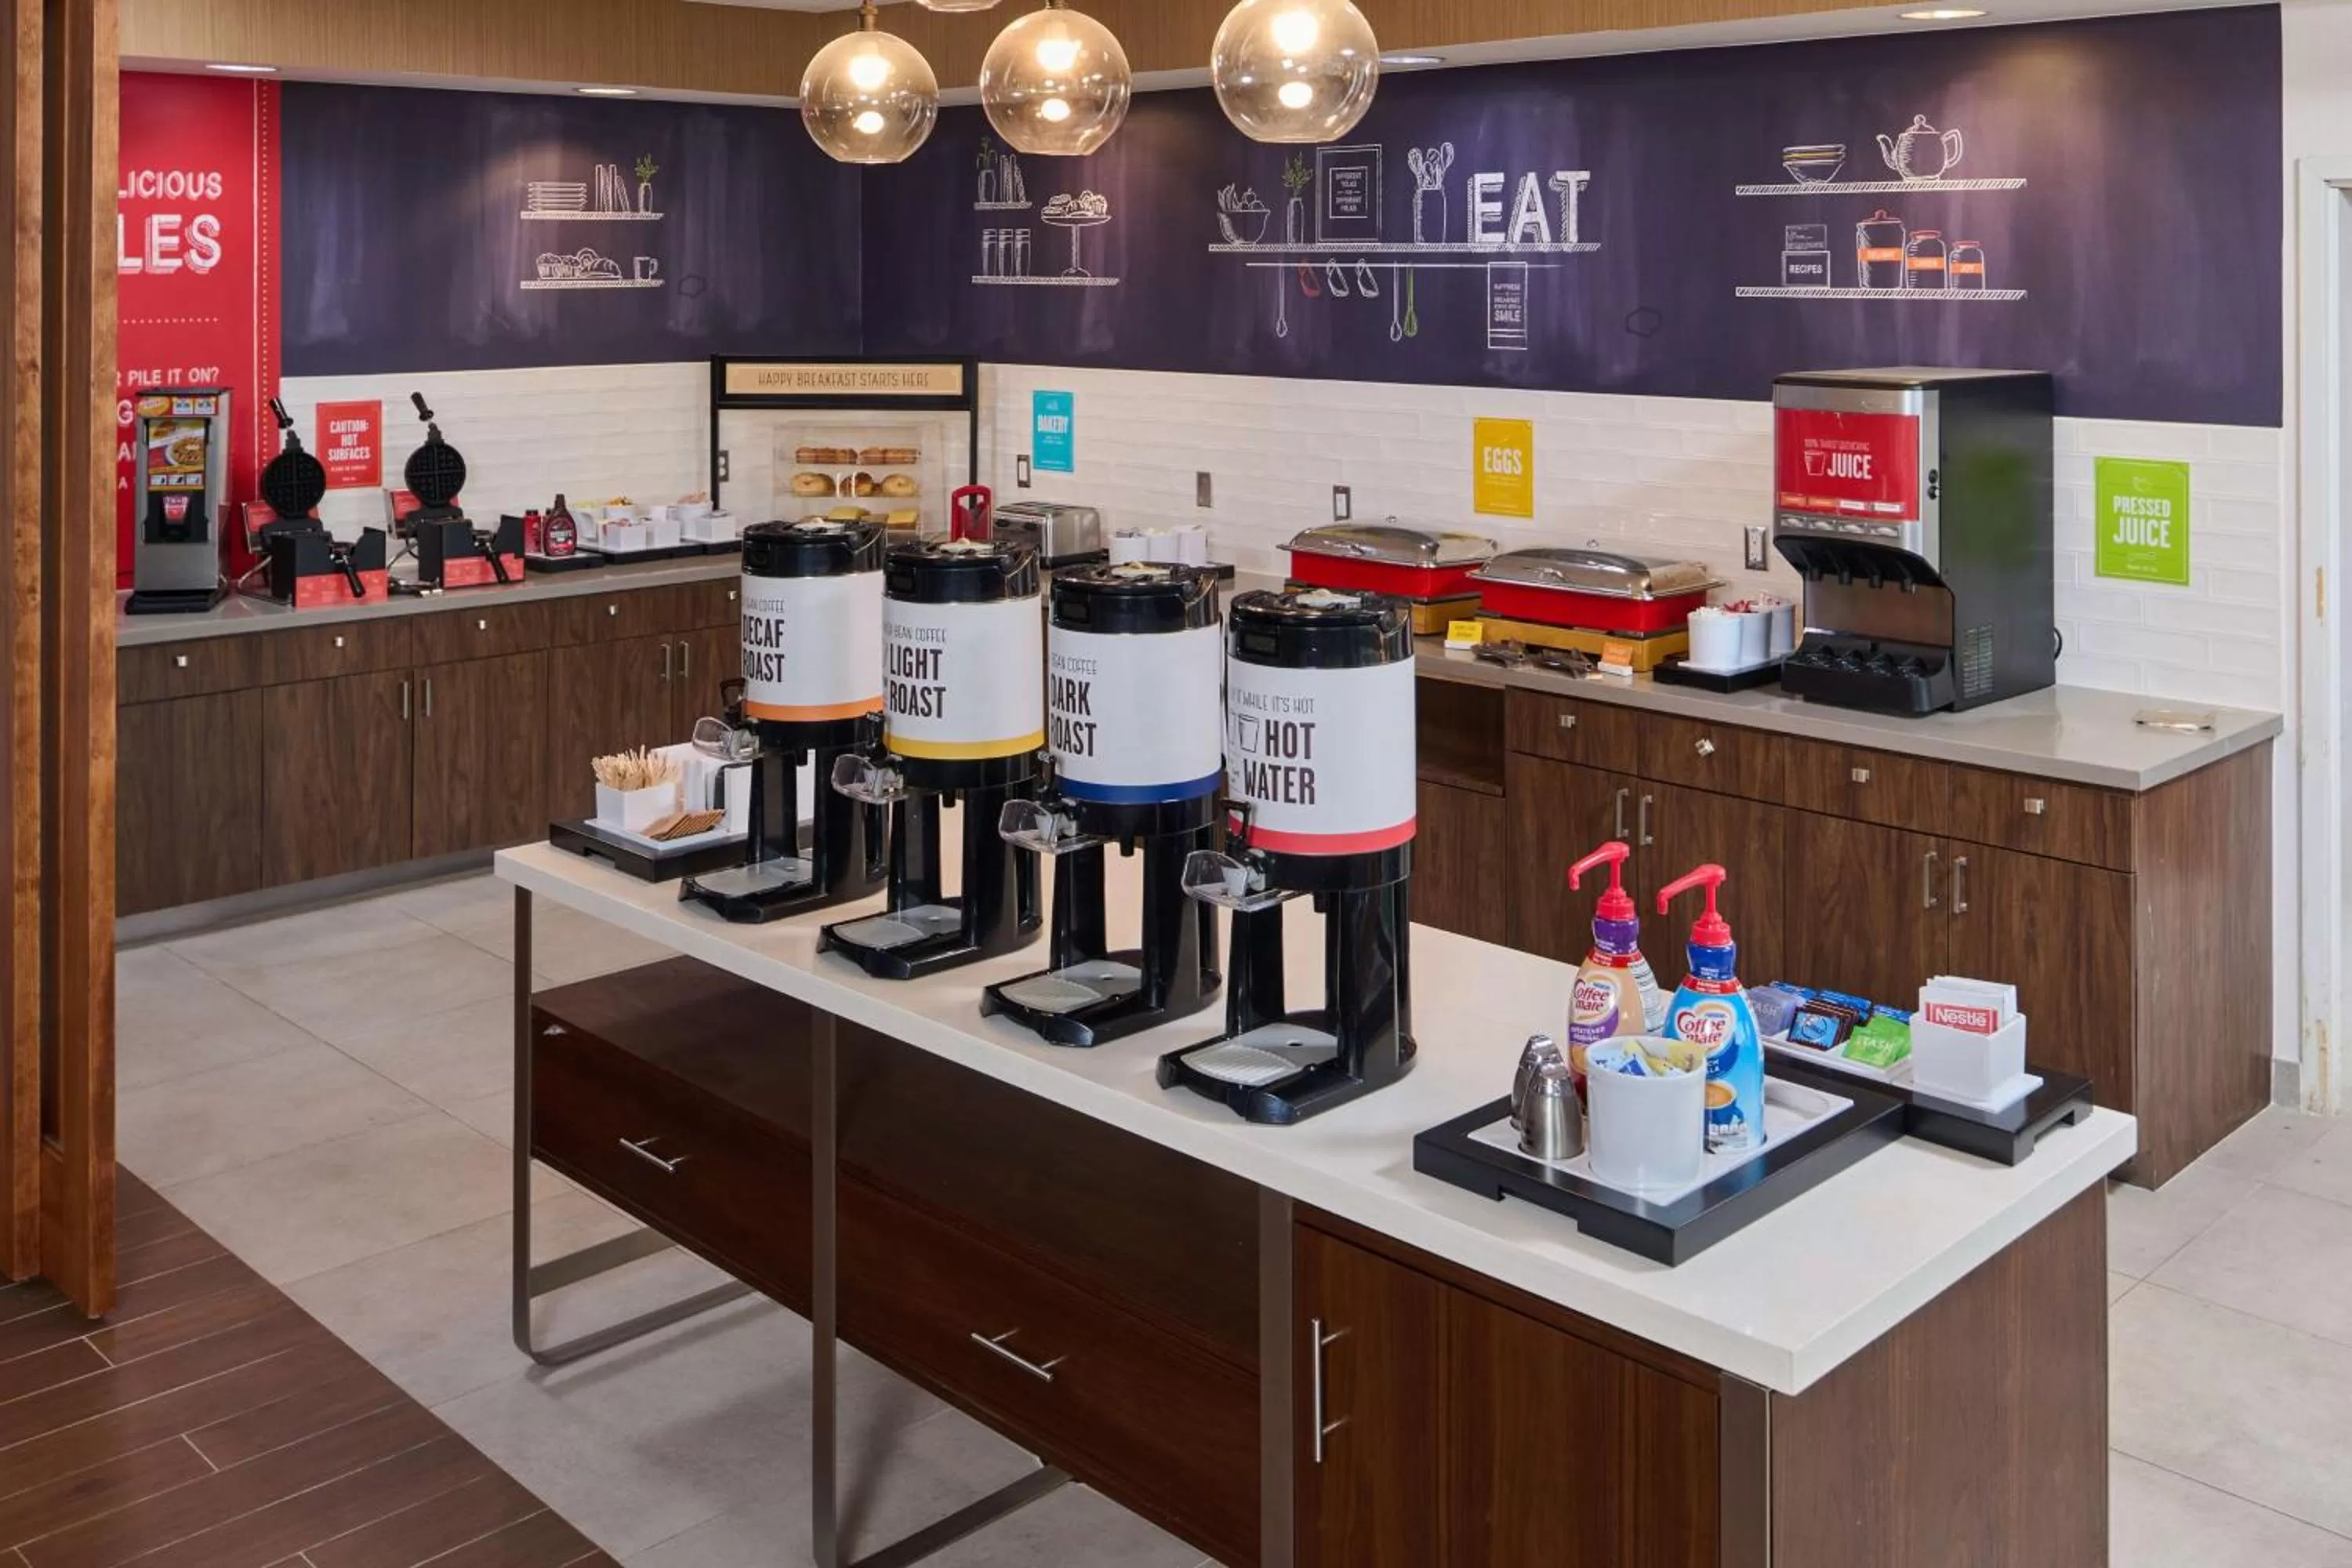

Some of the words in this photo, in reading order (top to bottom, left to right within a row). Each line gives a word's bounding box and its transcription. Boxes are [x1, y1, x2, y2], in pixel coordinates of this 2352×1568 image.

[1468, 170, 1591, 252] EAT
[1788, 263, 1824, 274] RECIPES
[1494, 310, 1521, 322] SMILE
[128, 369, 162, 387] PILE
[167, 368, 183, 385] IT
[187, 366, 220, 383] ON?
[758, 372, 793, 387] HAPPY
[797, 372, 856, 387] BREAKFAST
[859, 372, 898, 387] STARTS
[902, 372, 929, 387] HERE
[1037, 414, 1069, 435] BAKERY
[341, 434, 358, 447] HOT
[328, 445, 372, 462] SURFACES
[1483, 445, 1523, 475] EGGS
[1827, 452, 1873, 481] JUICE
[2113, 495, 2172, 518] PRESSED
[2112, 516, 2172, 548] JUICE
[742, 614, 785, 648] DECAF
[890, 643, 943, 681] LIGHT
[889, 680, 947, 719] ROAST
[1050, 672, 1091, 717] DARK
[1293, 698, 1315, 715] HOT
[1050, 712, 1098, 757] ROAST
[1265, 719, 1316, 760] HOT
[1243, 758, 1316, 805] WATER
[1574, 978, 1610, 1001] Coffee
[1575, 1000, 1604, 1012] mate
[1677, 1010, 1726, 1035] Coffee
